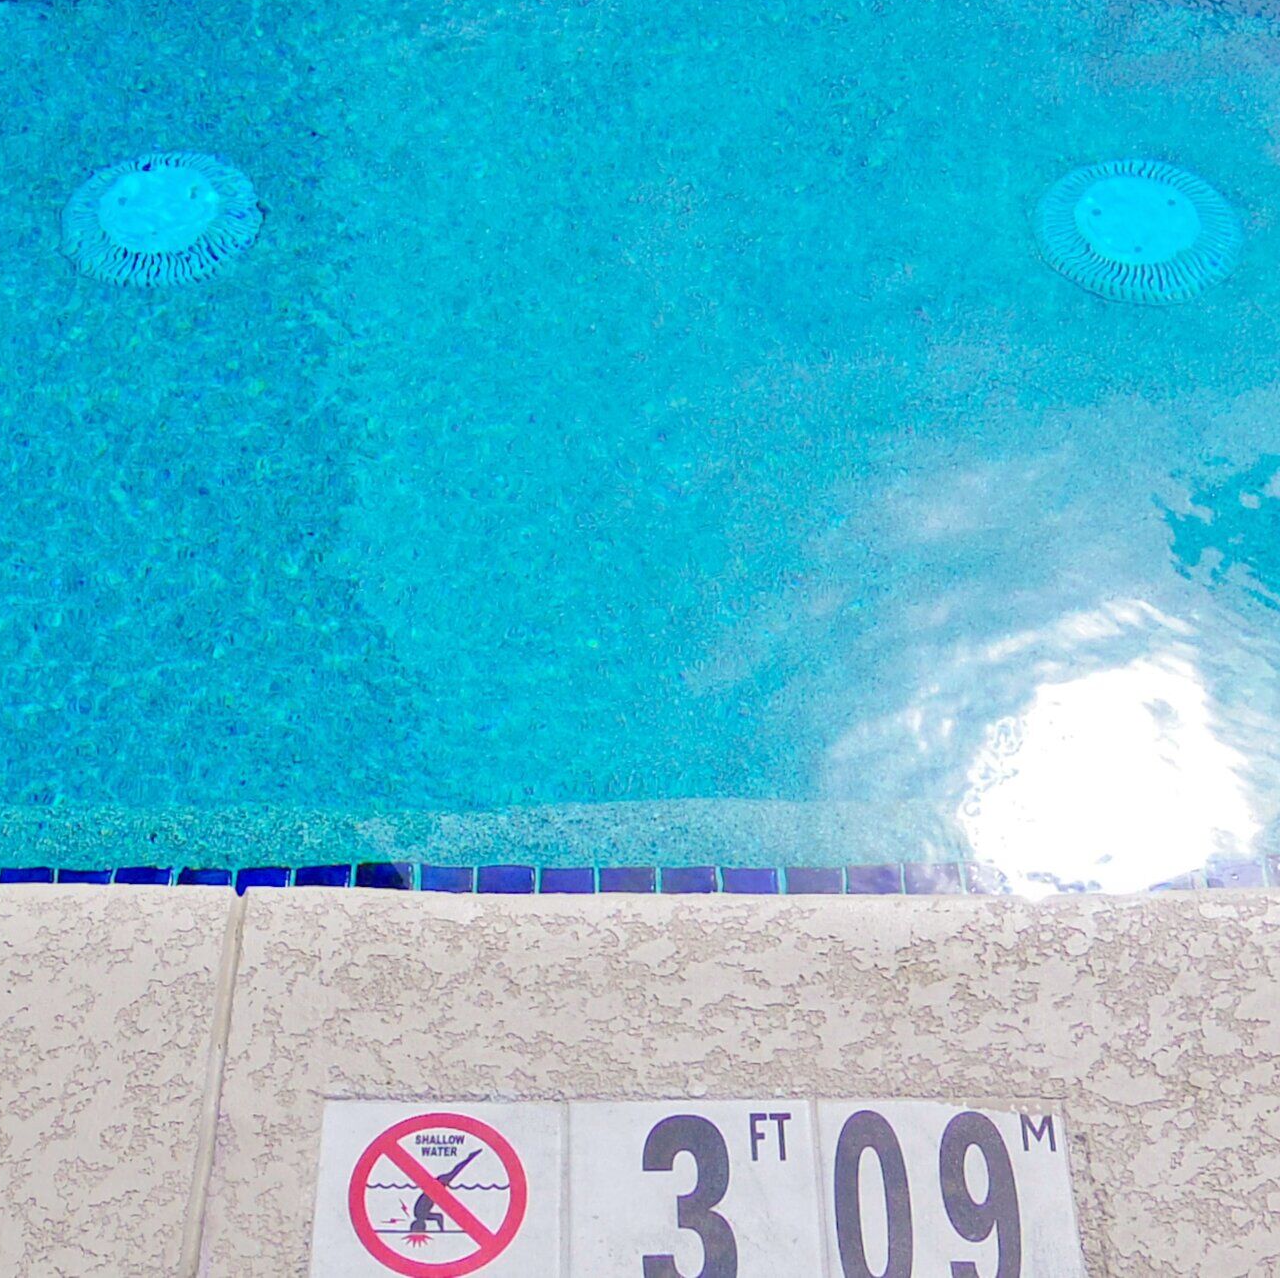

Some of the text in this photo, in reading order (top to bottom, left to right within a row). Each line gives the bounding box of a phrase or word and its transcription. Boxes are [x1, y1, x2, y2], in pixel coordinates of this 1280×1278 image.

[415, 1134, 465, 1157] SHALLOW WATER
[1020, 1113, 1058, 1153] M
[642, 1113, 792, 1278] 3 FT
